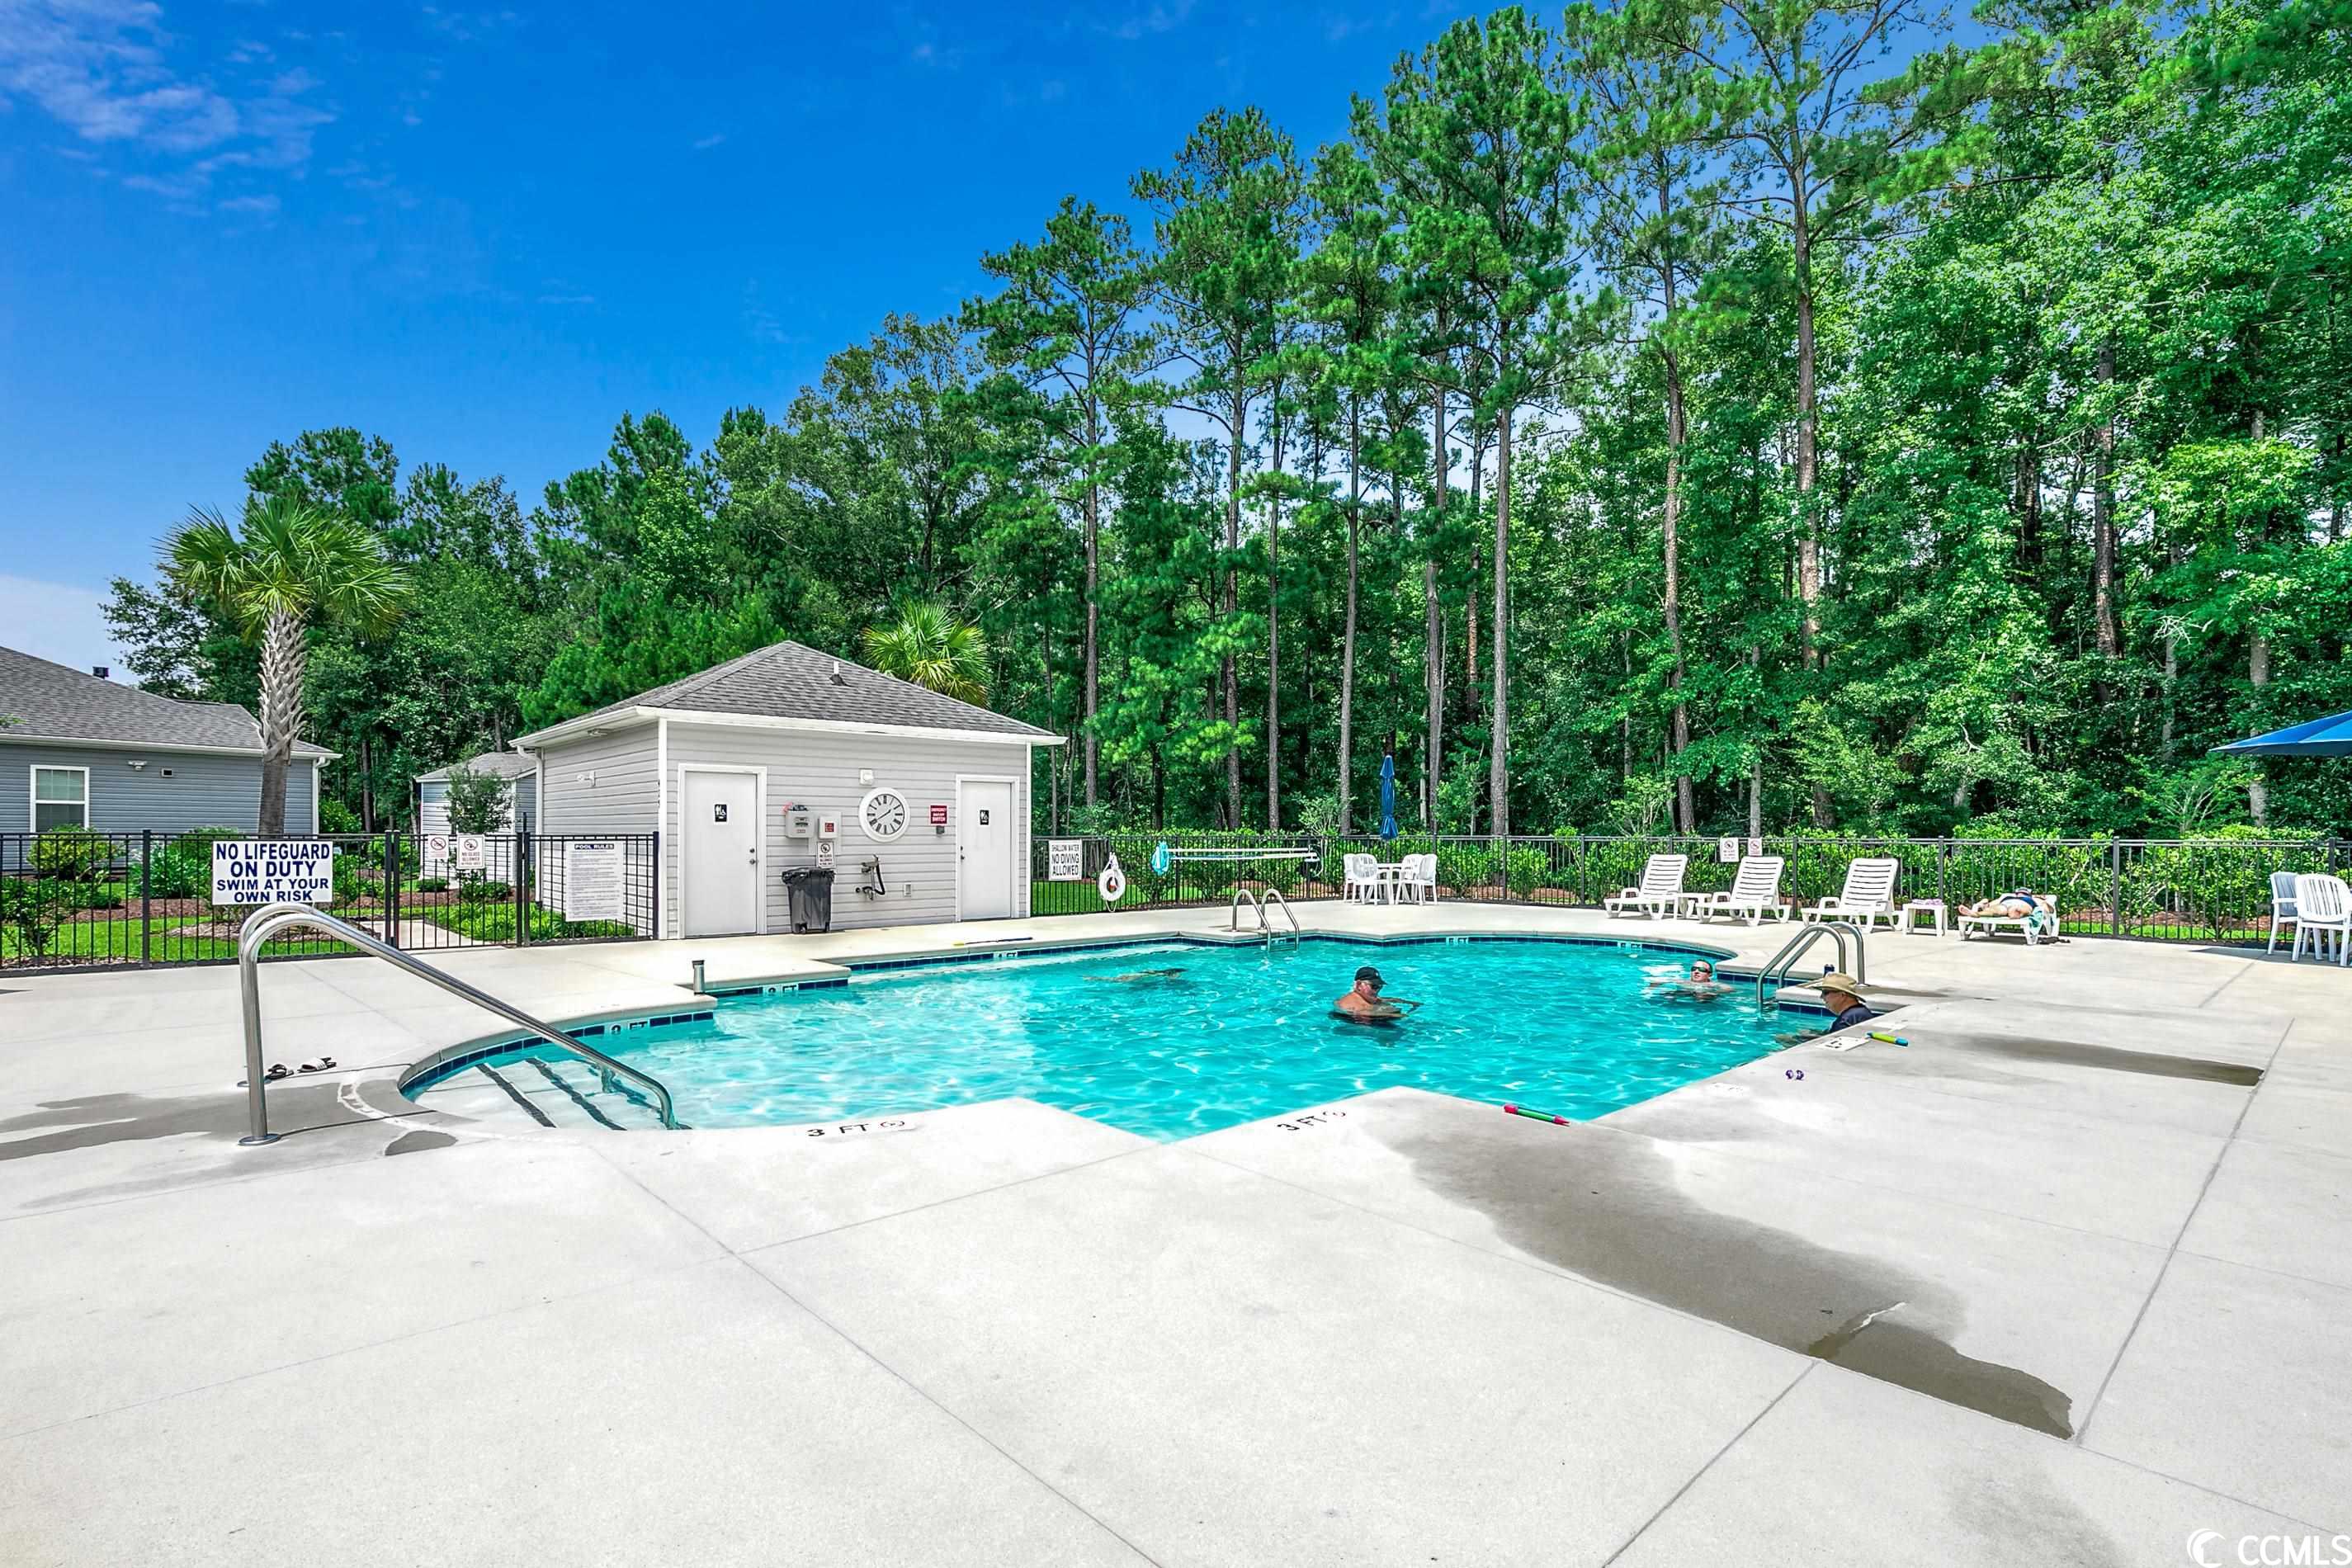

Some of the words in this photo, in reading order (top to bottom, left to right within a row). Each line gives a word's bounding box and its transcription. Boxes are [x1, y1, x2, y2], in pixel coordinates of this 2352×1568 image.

[216, 843, 239, 860] NO
[244, 843, 330, 860] LIFEGUARD
[1051, 853, 1060, 864] NO
[1060, 853, 1079, 864] DIVING
[230, 861, 258, 877] ON
[266, 861, 317, 877] DUTY
[1052, 865, 1079, 876] ALLOWED
[217, 879, 258, 890] SWIM
[264, 879, 283, 890] AT
[289, 878, 329, 890] YOUR
[234, 891, 270, 903] OWN
[276, 890, 313, 902] RISK
[807, 1128, 825, 1137] 3
[838, 1123, 870, 1134] FT
